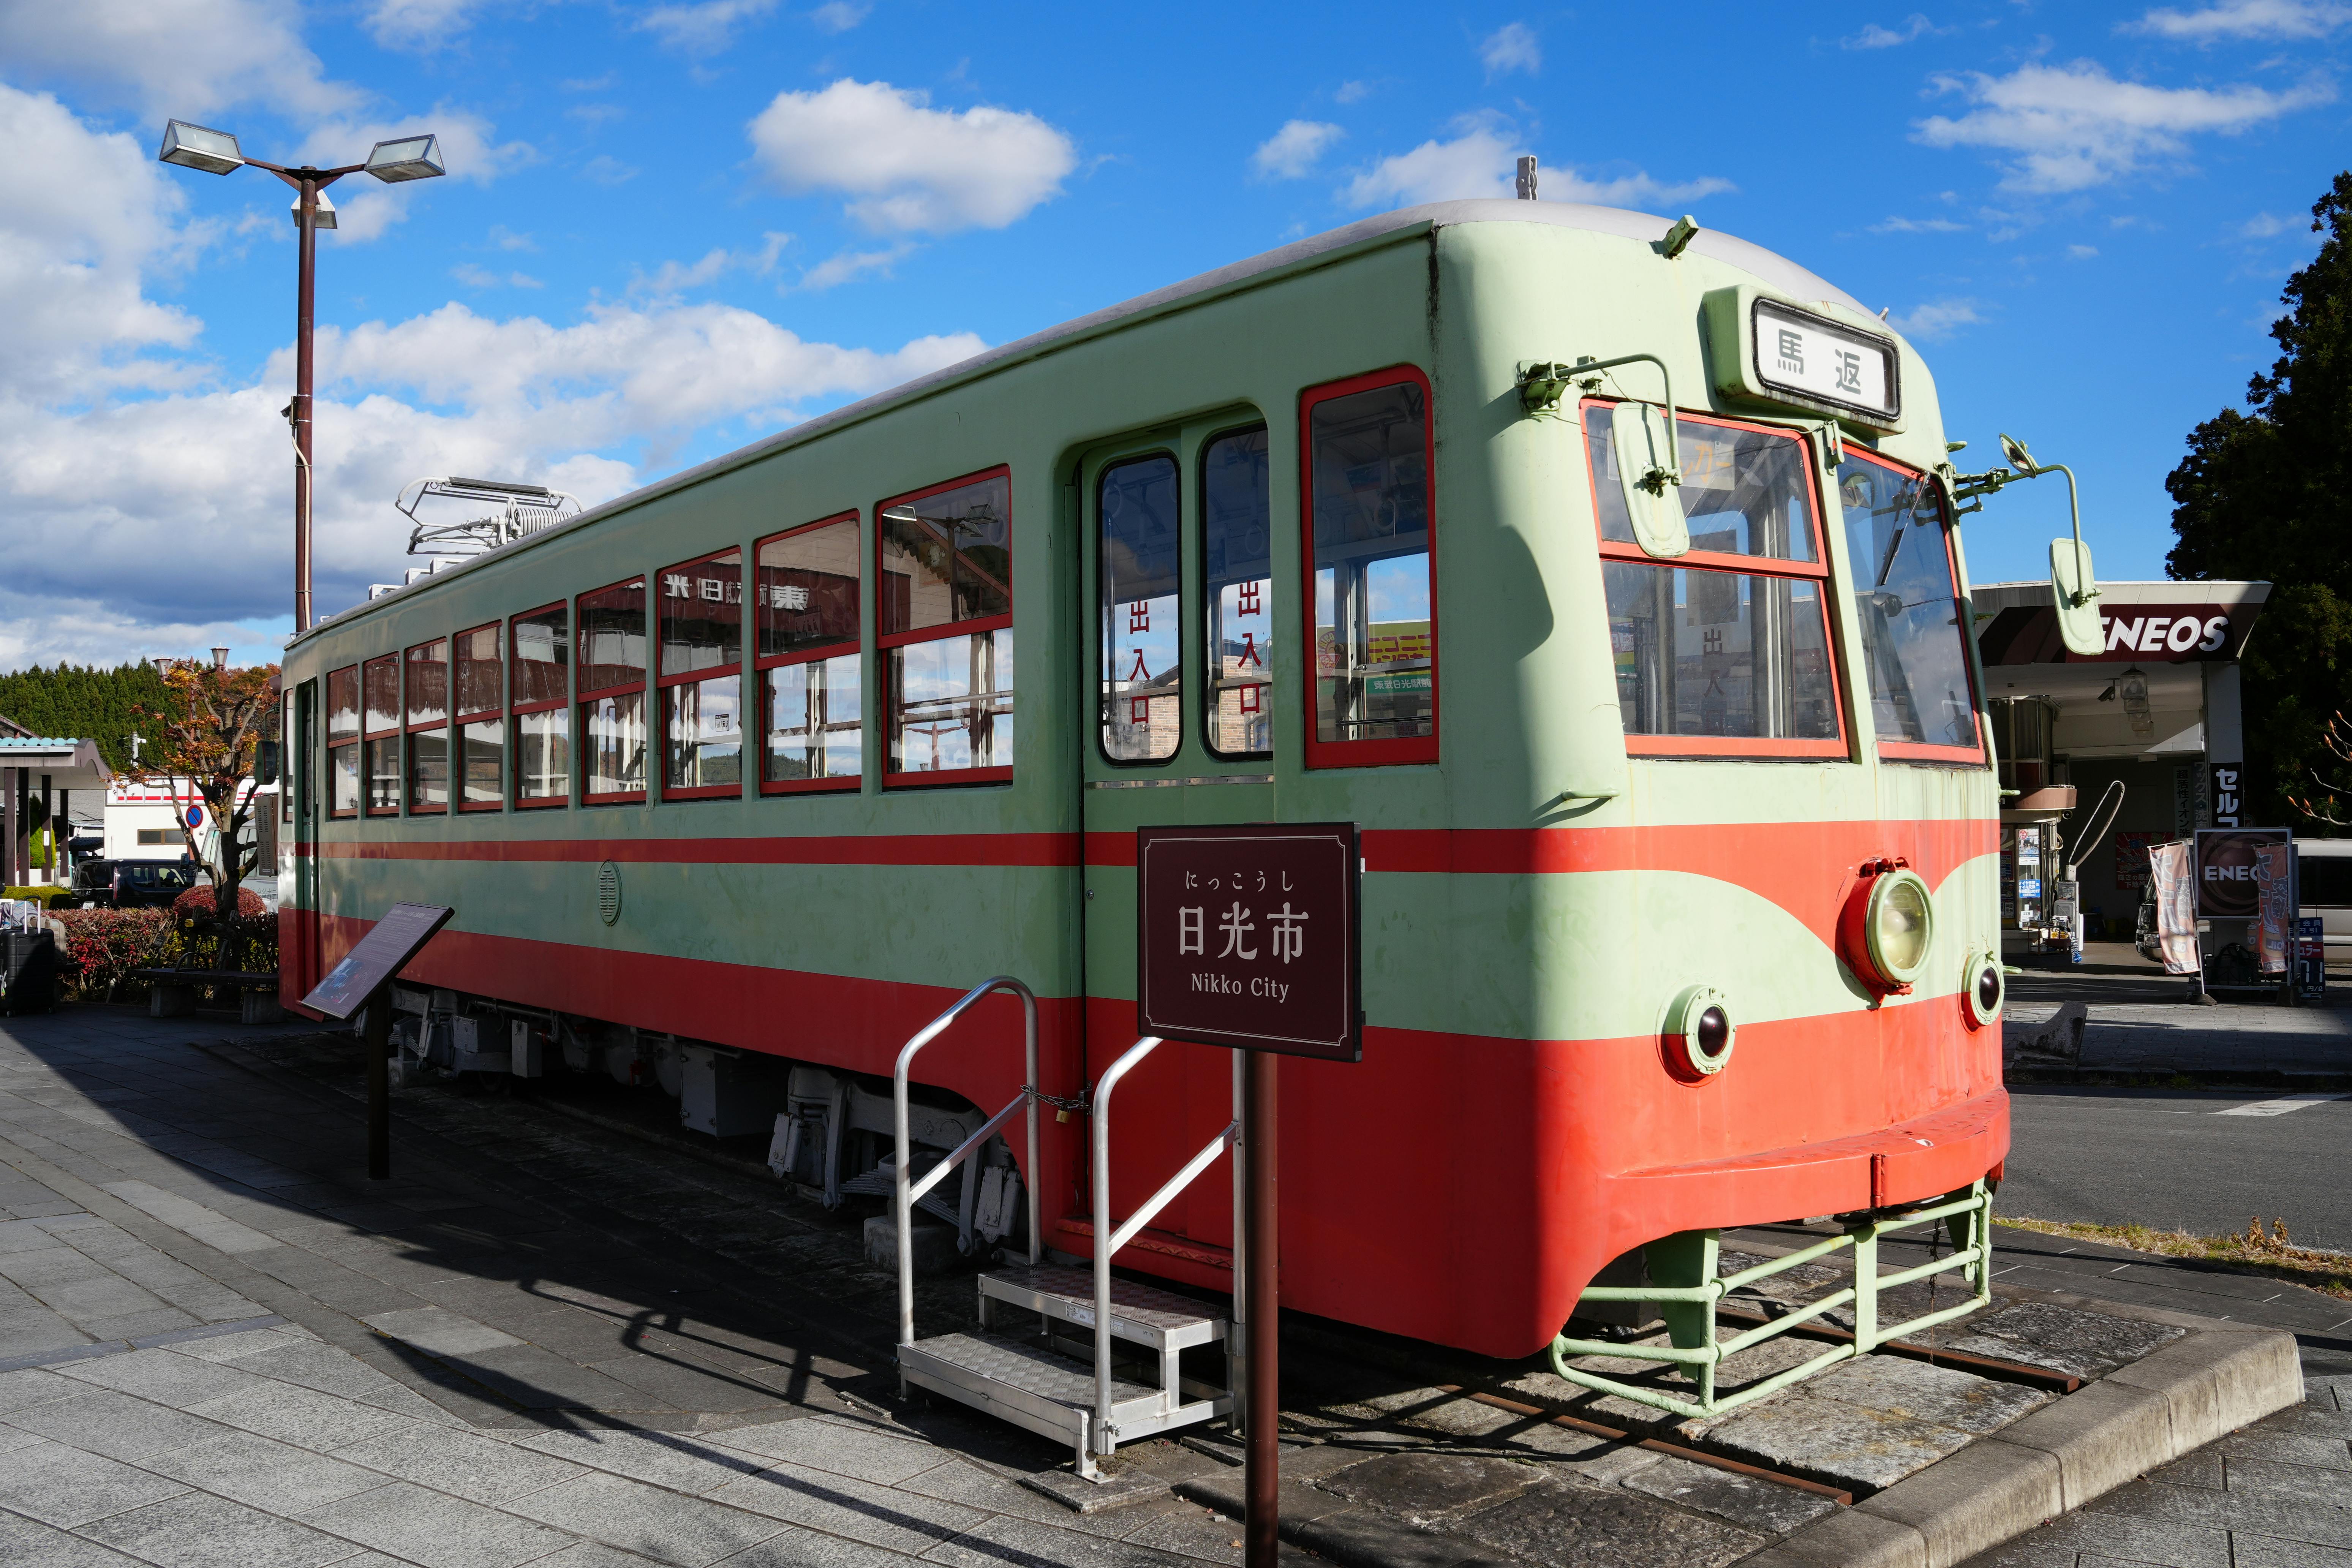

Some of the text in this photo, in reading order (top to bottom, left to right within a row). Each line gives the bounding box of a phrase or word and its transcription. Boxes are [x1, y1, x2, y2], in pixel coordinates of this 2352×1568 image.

[1778, 328, 1861, 395] 馬返
[1129, 599, 1150, 724] 出入口
[1238, 580, 1261, 714] 出入口
[1186, 871, 1293, 892] にっこうし
[2205, 866, 2258, 881] ENE
[1179, 901, 1309, 964] 日光市
[2285, 945, 2320, 956] レュラー
[1192, 973, 1289, 1003] Nikko City
